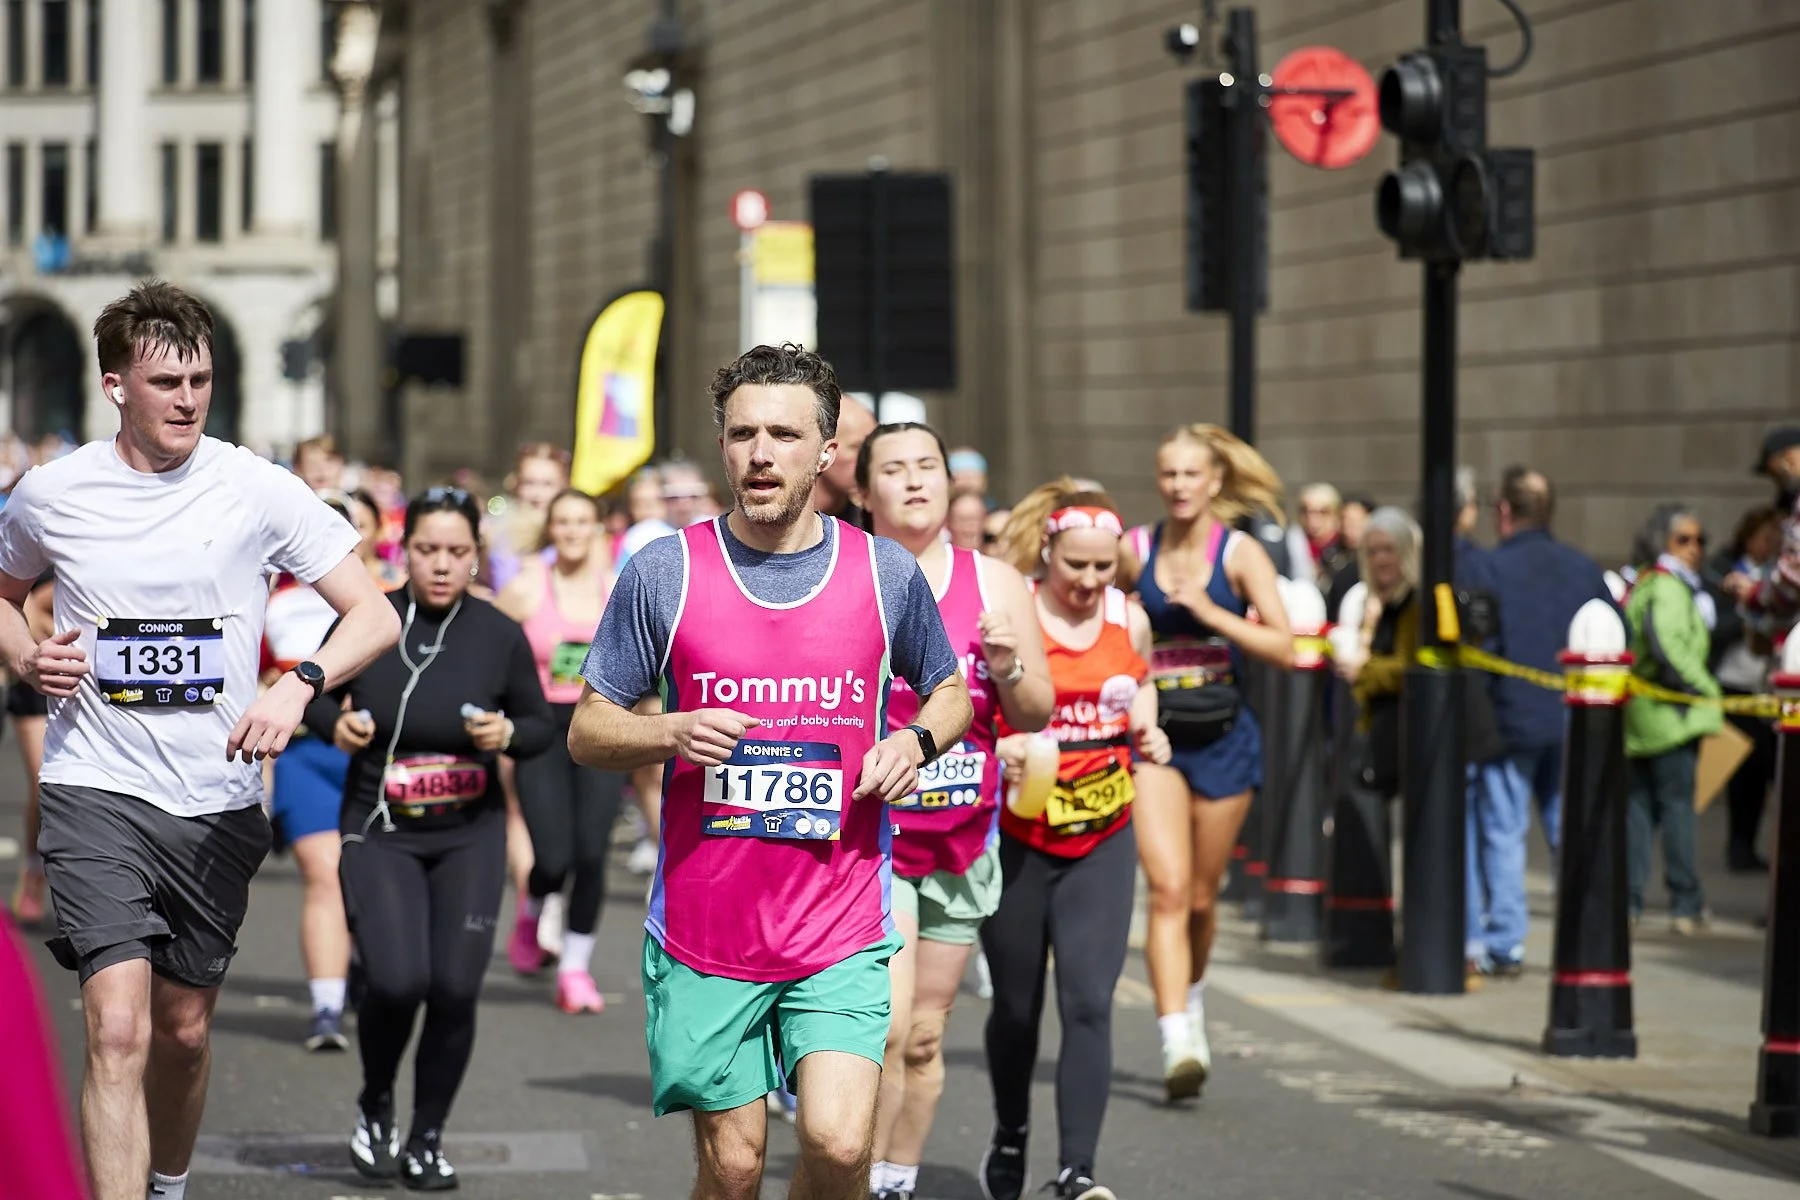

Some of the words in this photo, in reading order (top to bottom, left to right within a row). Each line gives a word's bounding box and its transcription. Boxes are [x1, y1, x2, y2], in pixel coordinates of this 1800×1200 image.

[138, 623, 184, 633] CONNOR
[117, 645, 201, 675] 1331
[692, 670, 866, 710] Tommy's
[776, 715, 798, 727] and
[801, 714, 829, 728] baby
[832, 714, 865, 729] charity
[743, 745, 791, 757] RONNIE
[793, 746, 803, 758] C
[917, 757, 976, 780] 988
[715, 768, 833, 805] 11786
